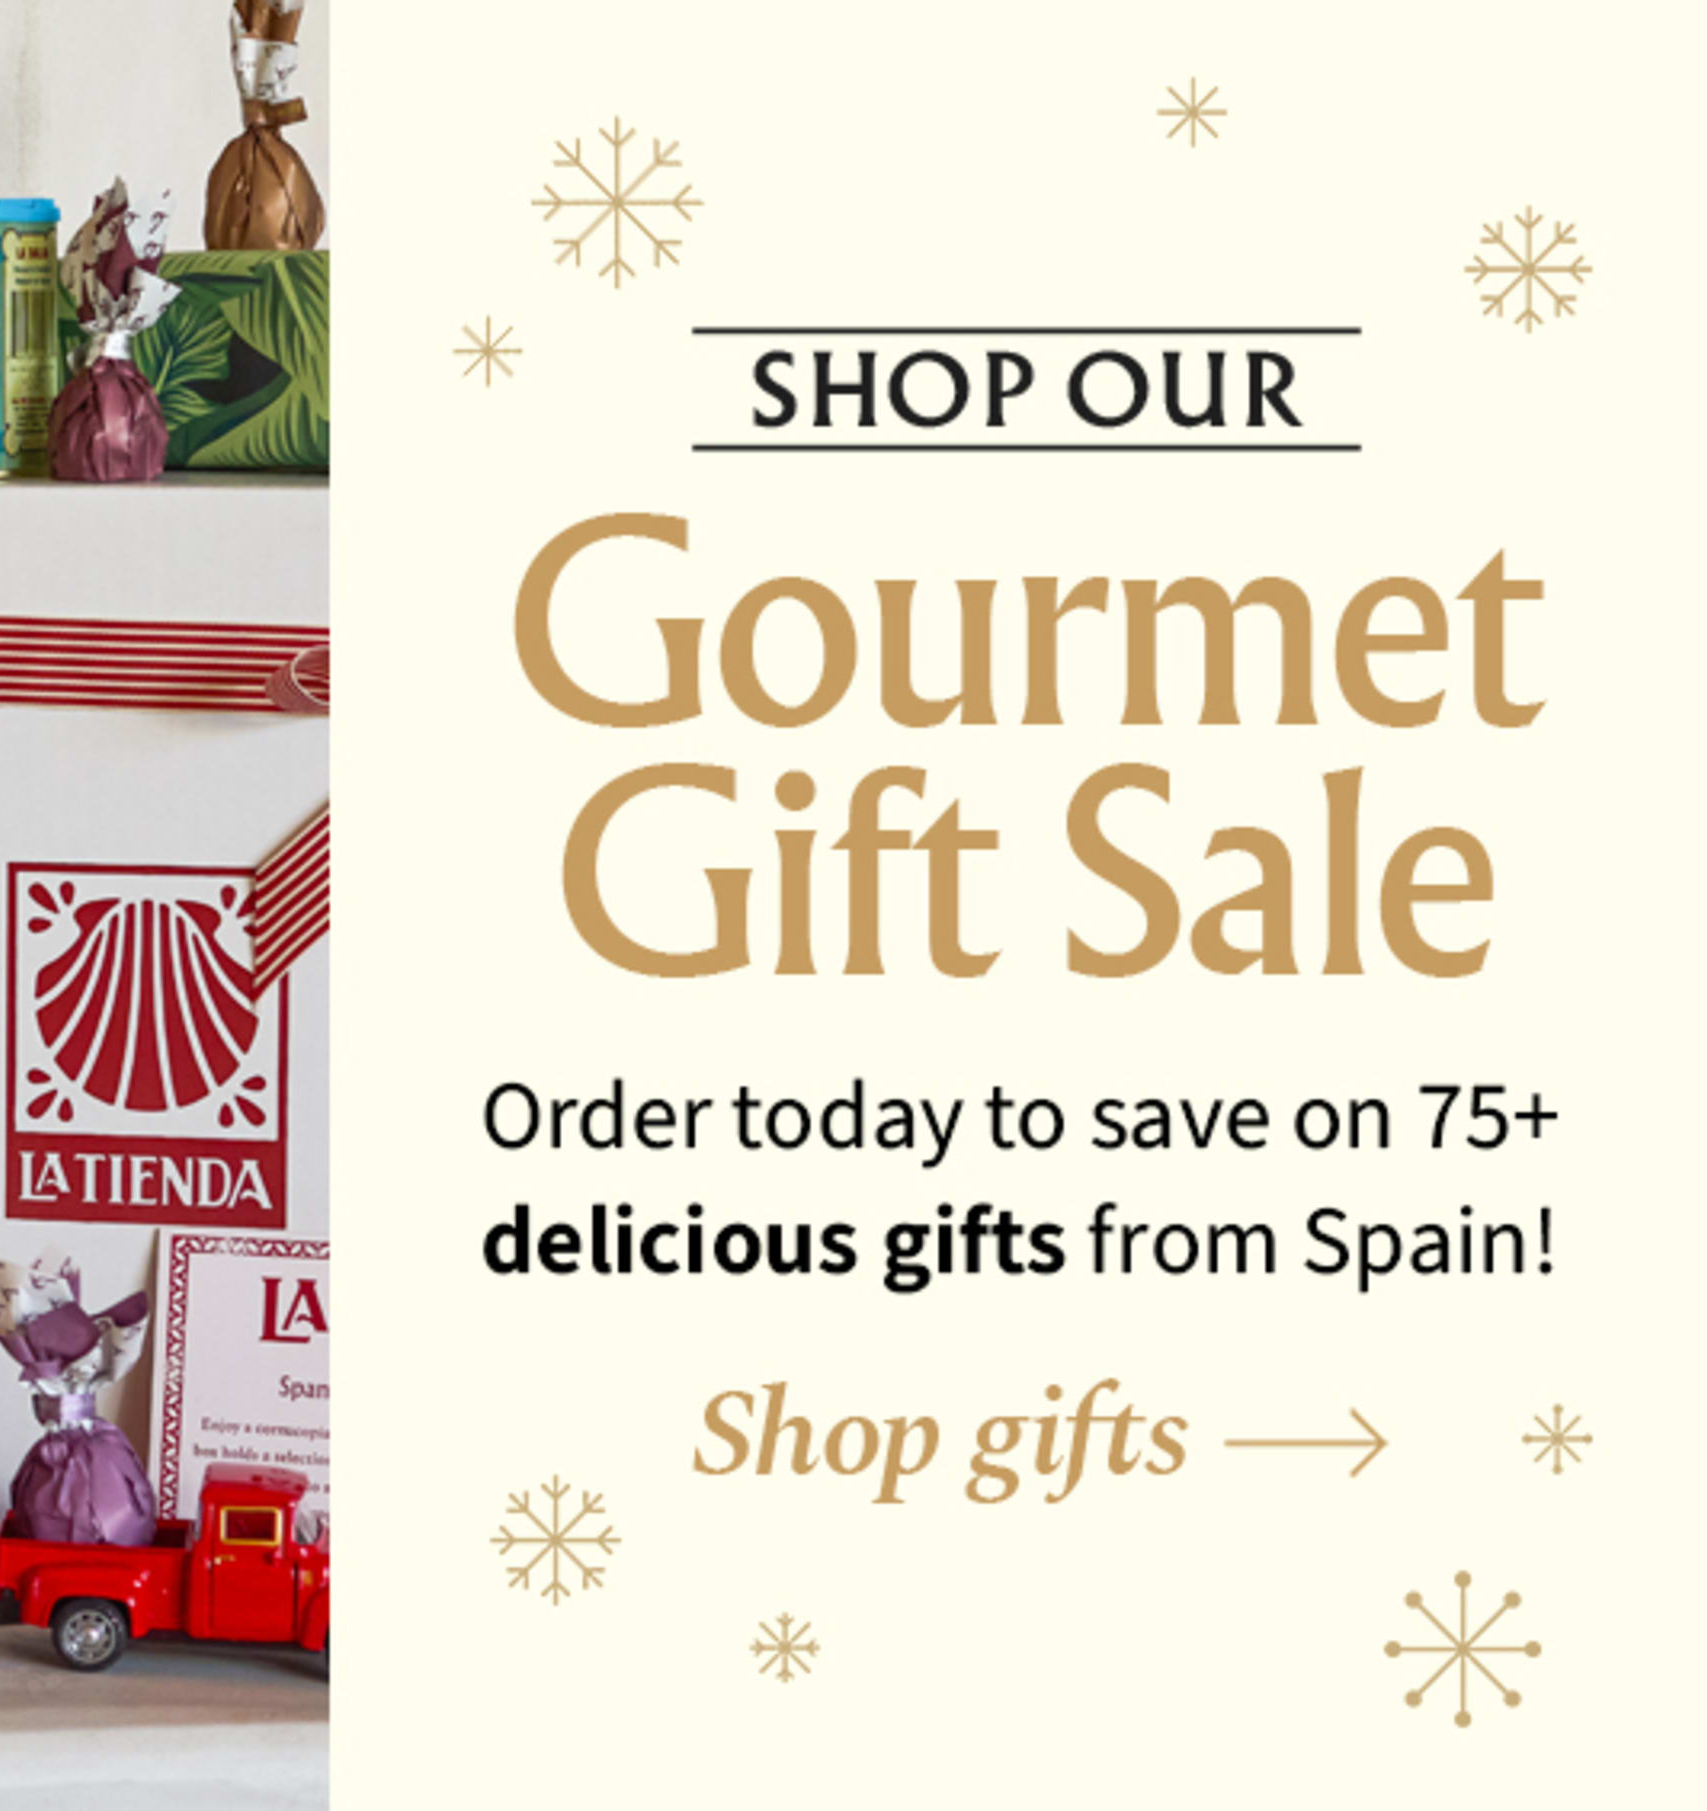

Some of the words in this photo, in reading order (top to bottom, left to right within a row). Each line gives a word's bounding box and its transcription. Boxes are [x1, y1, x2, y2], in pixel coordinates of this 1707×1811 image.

[19, 1150, 71, 1203] LA
[73, 1154, 273, 1211] TIENDA
[258, 1276, 329, 1344] LA
